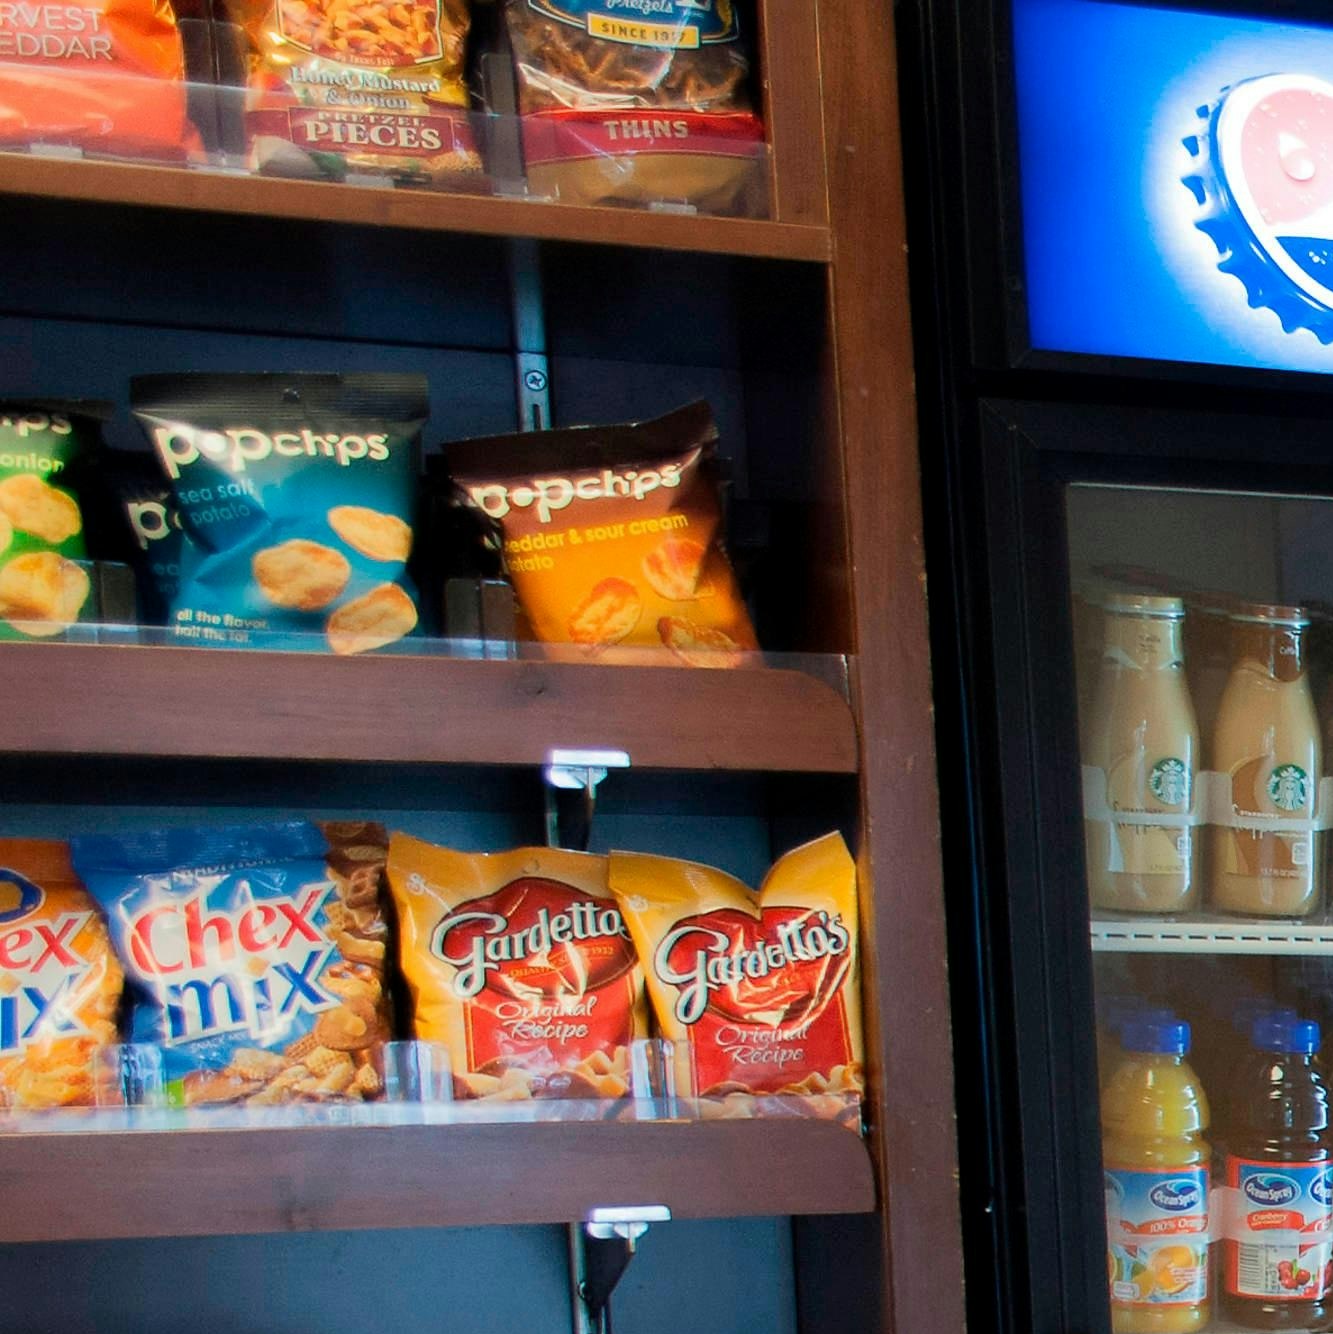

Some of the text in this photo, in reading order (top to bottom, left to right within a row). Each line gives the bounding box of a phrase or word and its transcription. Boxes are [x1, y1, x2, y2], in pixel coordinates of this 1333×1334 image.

[601, 22, 648, 39] SINCE
[357, 70, 440, 94] Mustard
[306, 124, 442, 150] PIECES
[604, 120, 689, 140] THINS
[154, 428, 392, 480] popchips
[179, 478, 257, 505] sea salt
[190, 503, 252, 527] potato
[569, 514, 690, 546] & sour cream
[197, 611, 222, 626] the
[130, 888, 325, 975] Chex
[654, 909, 850, 1025] Gardetto's
[168, 950, 330, 1042] mix
[495, 996, 598, 1021] Original
[502, 1019, 588, 1045] Recipe
[714, 1024, 812, 1048] Original
[730, 1045, 805, 1069] Recipe
